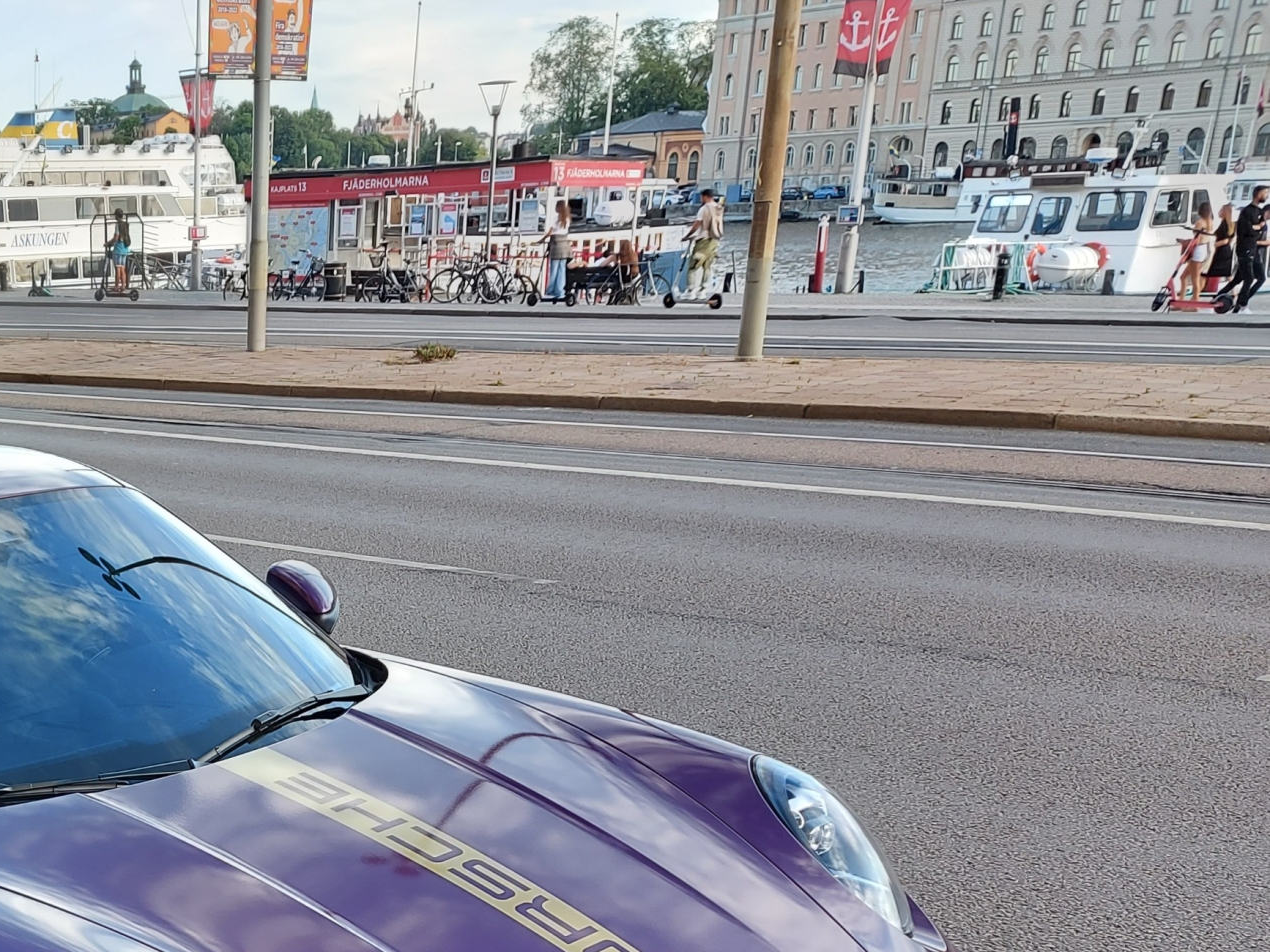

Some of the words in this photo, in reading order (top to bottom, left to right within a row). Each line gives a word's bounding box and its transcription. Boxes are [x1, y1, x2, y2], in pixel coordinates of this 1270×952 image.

[57, 121, 73, 139] C
[553, 166, 565, 181] 13
[270, 184, 297, 194] KAJPLATS
[298, 181, 307, 192] 13
[342, 174, 429, 191] FJÄDERHOLMARNA
[10, 231, 71, 248] ASKUNGEN
